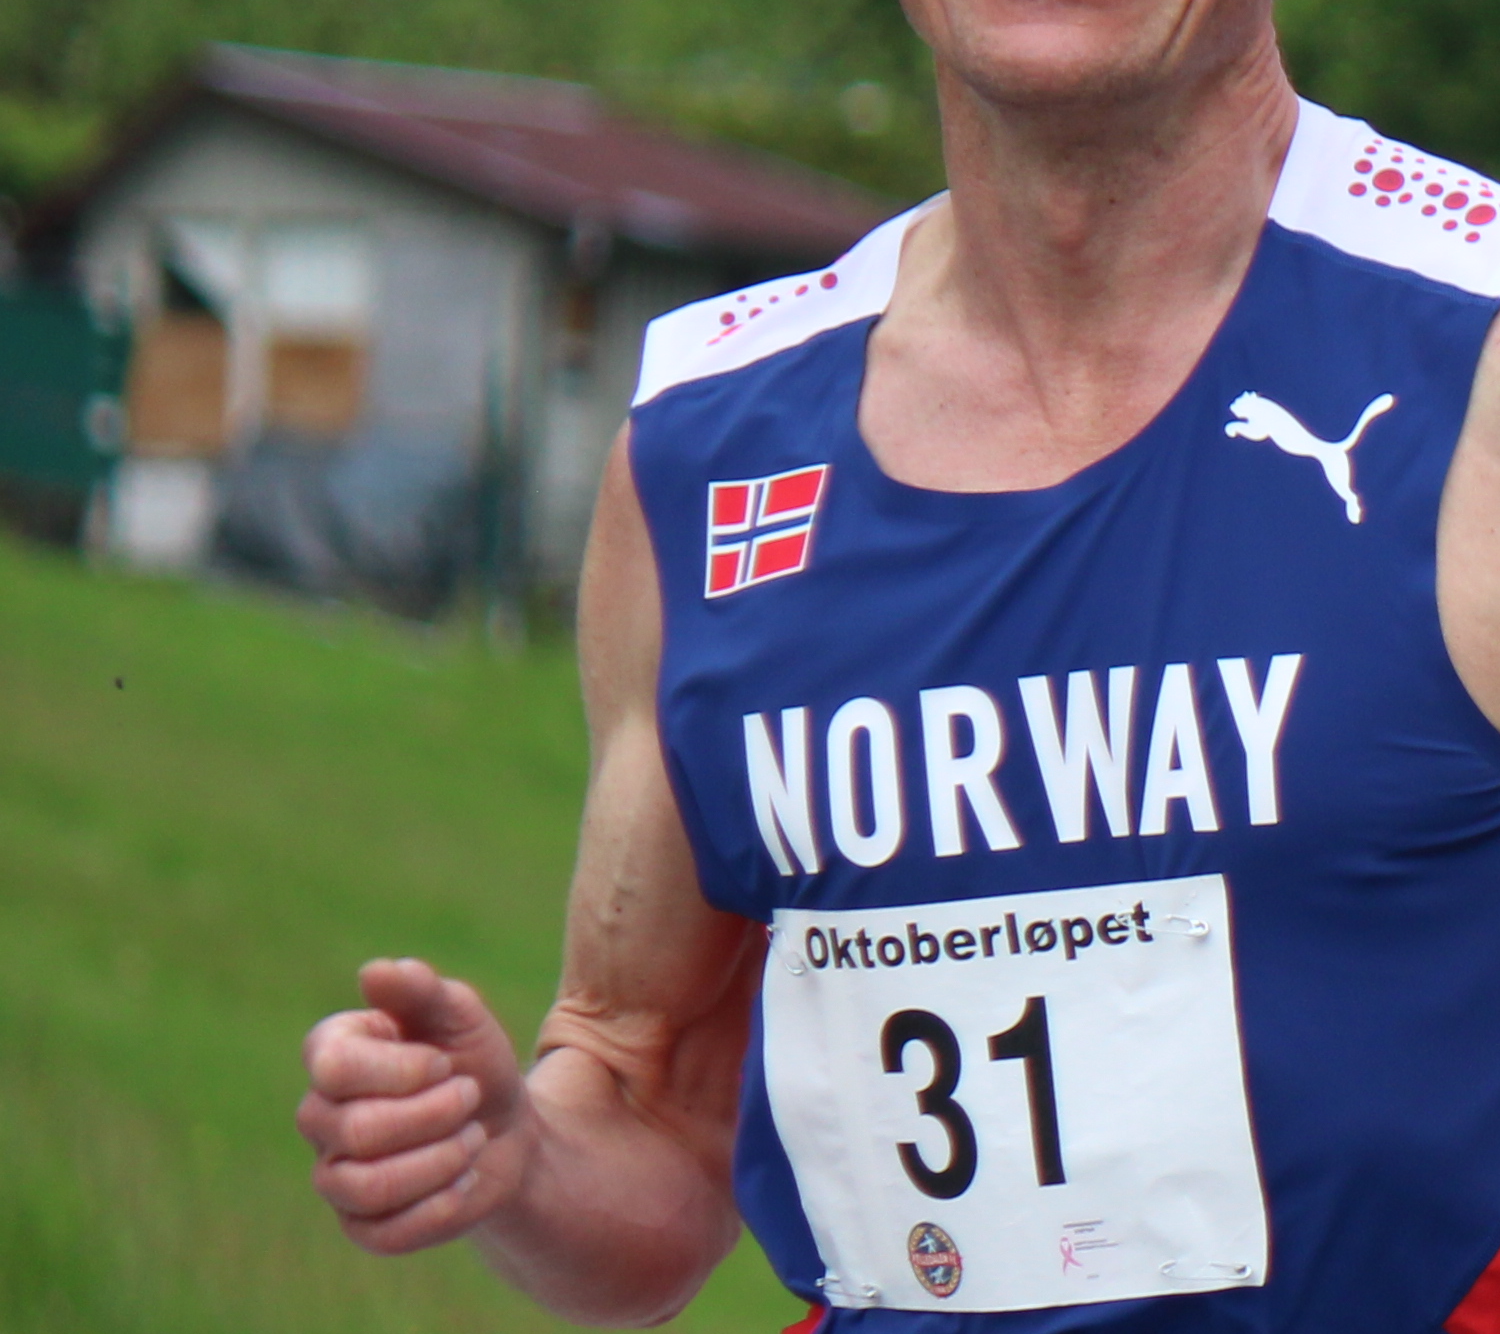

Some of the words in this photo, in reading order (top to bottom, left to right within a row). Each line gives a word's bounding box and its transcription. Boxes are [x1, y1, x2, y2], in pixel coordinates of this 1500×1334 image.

[743, 653, 1304, 876] NORWAY
[806, 901, 1153, 973] Oktoberløpet
[880, 995, 1069, 1201] 31
